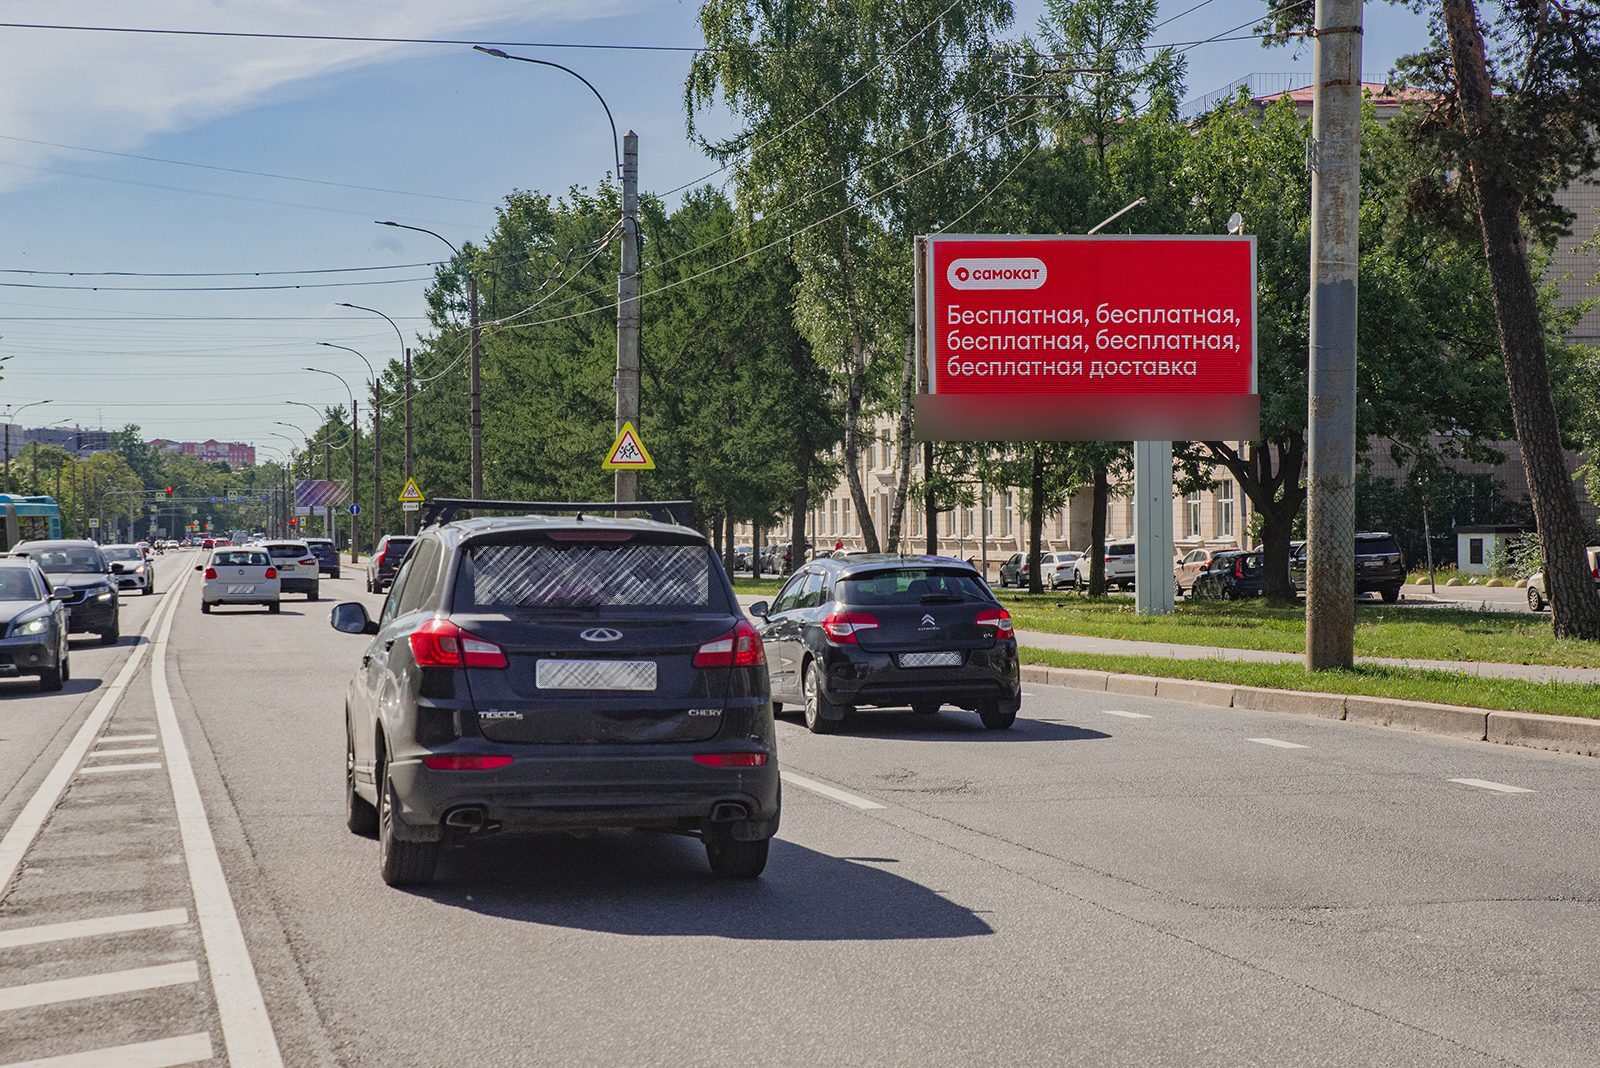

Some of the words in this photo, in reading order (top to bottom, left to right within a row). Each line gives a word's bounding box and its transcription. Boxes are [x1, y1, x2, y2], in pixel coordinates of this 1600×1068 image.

[972, 268, 1040, 280] самокат
[947, 304, 1090, 328] Бесплатная,
[1096, 302, 1241, 328] бесплатная,
[947, 329, 1090, 353] бесплатная,
[1095, 328, 1241, 353] бесплатная,
[947, 355, 1083, 376] бесплатная
[1089, 361, 1197, 379] доставка
[688, 709, 723, 717] CHERY
